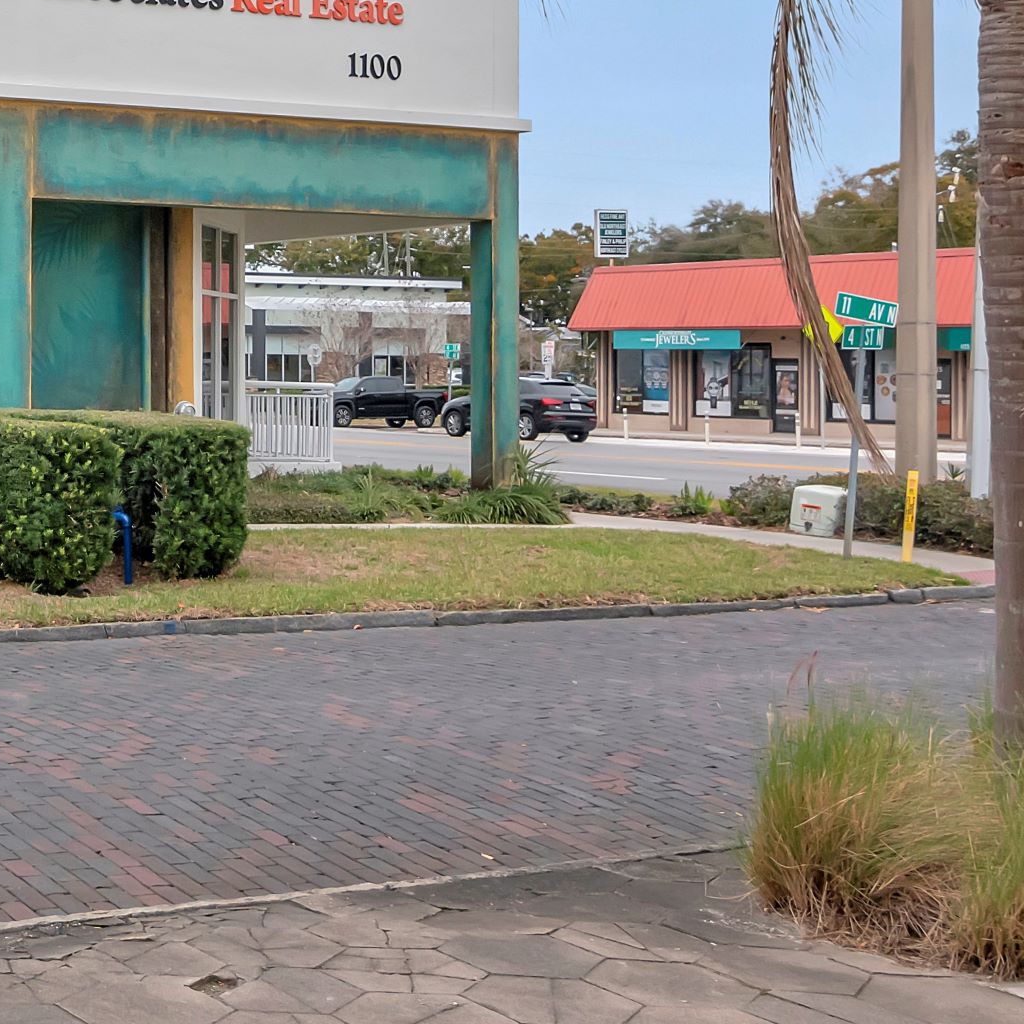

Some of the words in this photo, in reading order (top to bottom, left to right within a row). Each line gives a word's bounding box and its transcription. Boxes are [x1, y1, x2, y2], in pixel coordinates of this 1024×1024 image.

[347, 52, 402, 81] 1100
[841, 296, 852, 315] 11
[868, 302, 885, 321] AV
[886, 305, 896, 324] N
[655, 332, 696, 349] JEWELERS
[847, 328, 855, 346] 4
[864, 328, 875, 346] ST
[876, 328, 883, 346] N
